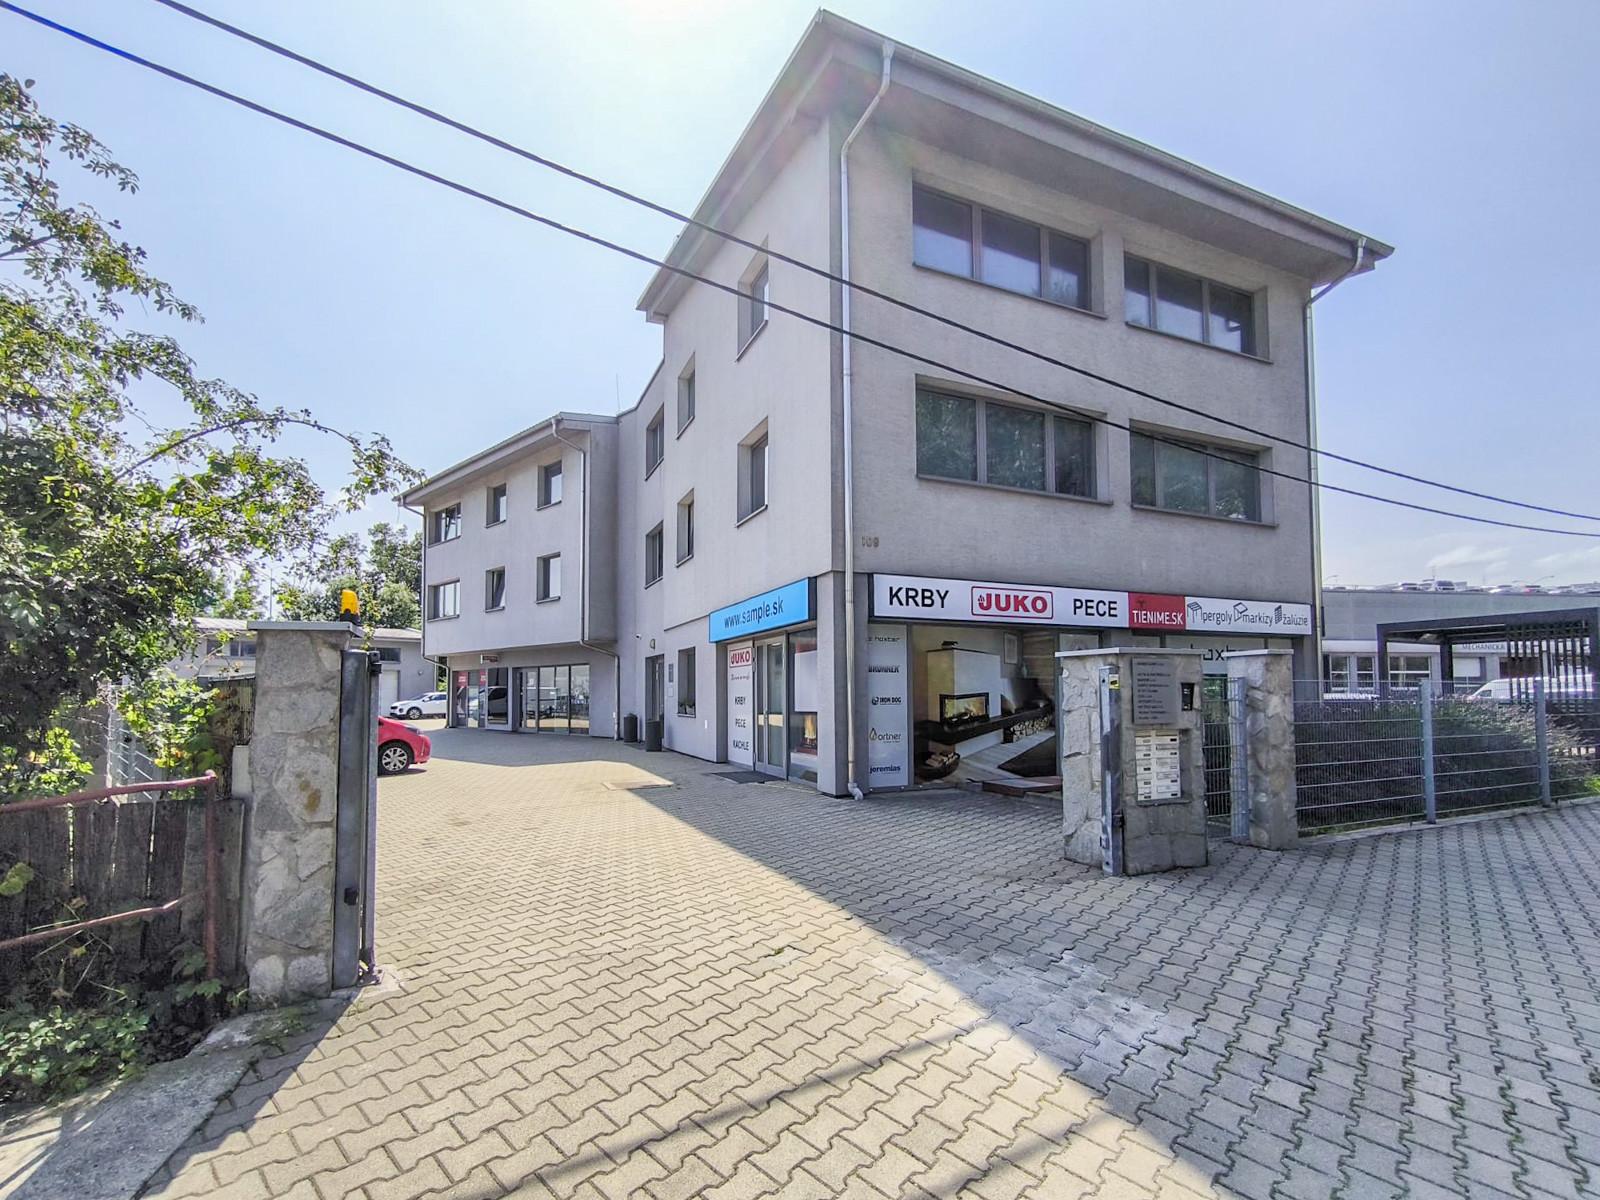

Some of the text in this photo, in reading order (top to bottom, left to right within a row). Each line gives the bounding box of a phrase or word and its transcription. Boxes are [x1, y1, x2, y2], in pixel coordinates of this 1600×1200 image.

[889, 586, 950, 609] KRBY
[978, 592, 1049, 613] JUKO
[723, 596, 784, 629] www.sample.sk
[1073, 598, 1118, 618] PECE
[1132, 610, 1184, 625] TIENIME.SK
[1202, 609, 1233, 626] pergoly
[730, 650, 751, 665] JUKO
[734, 696, 746, 705] KRBY
[877, 732, 902, 741] ortner
